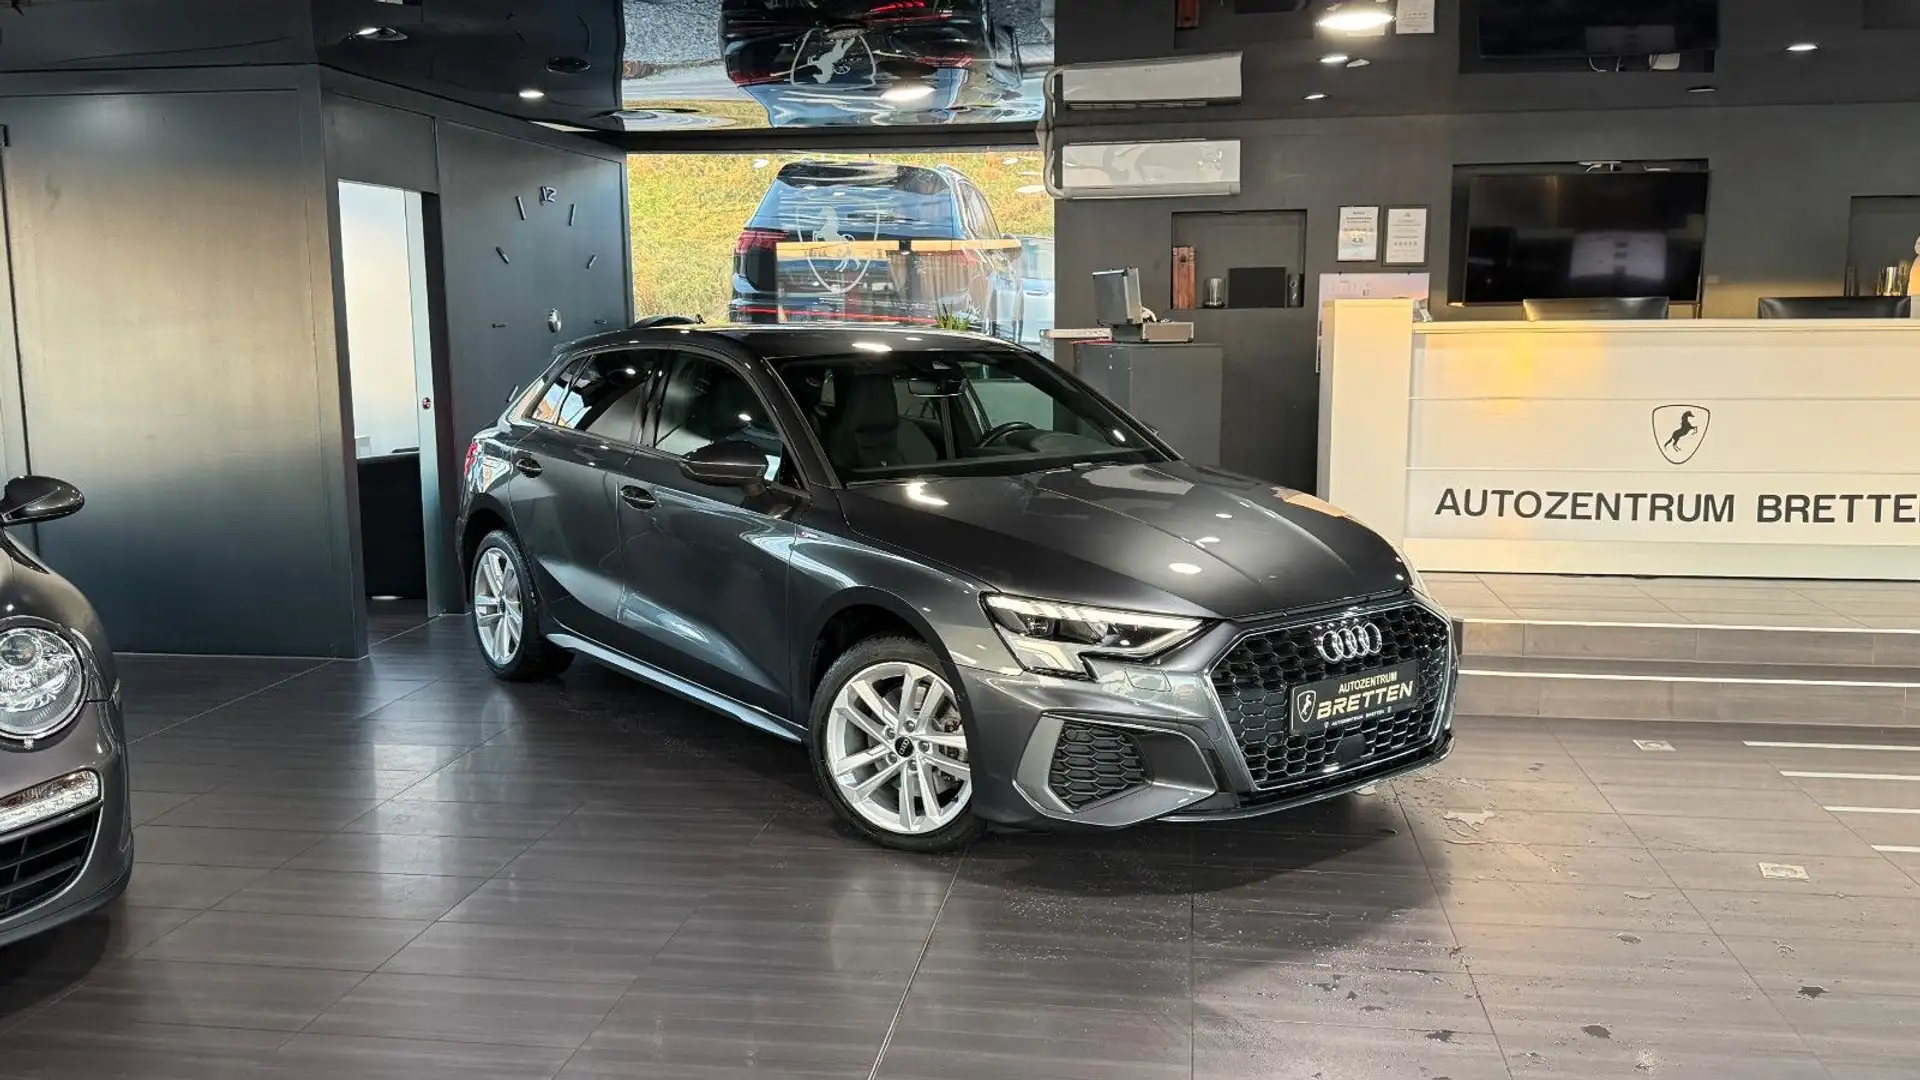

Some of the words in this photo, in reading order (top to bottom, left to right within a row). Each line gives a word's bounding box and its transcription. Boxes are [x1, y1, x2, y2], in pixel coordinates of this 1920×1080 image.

[540, 186, 557, 203] 12
[1435, 488, 1735, 522] AUTOZENTRUM
[1757, 494, 1920, 523] BRETTE
[1338, 671, 1398, 694] AUTOZENTRUM
[1316, 681, 1414, 719] BRETTEN
